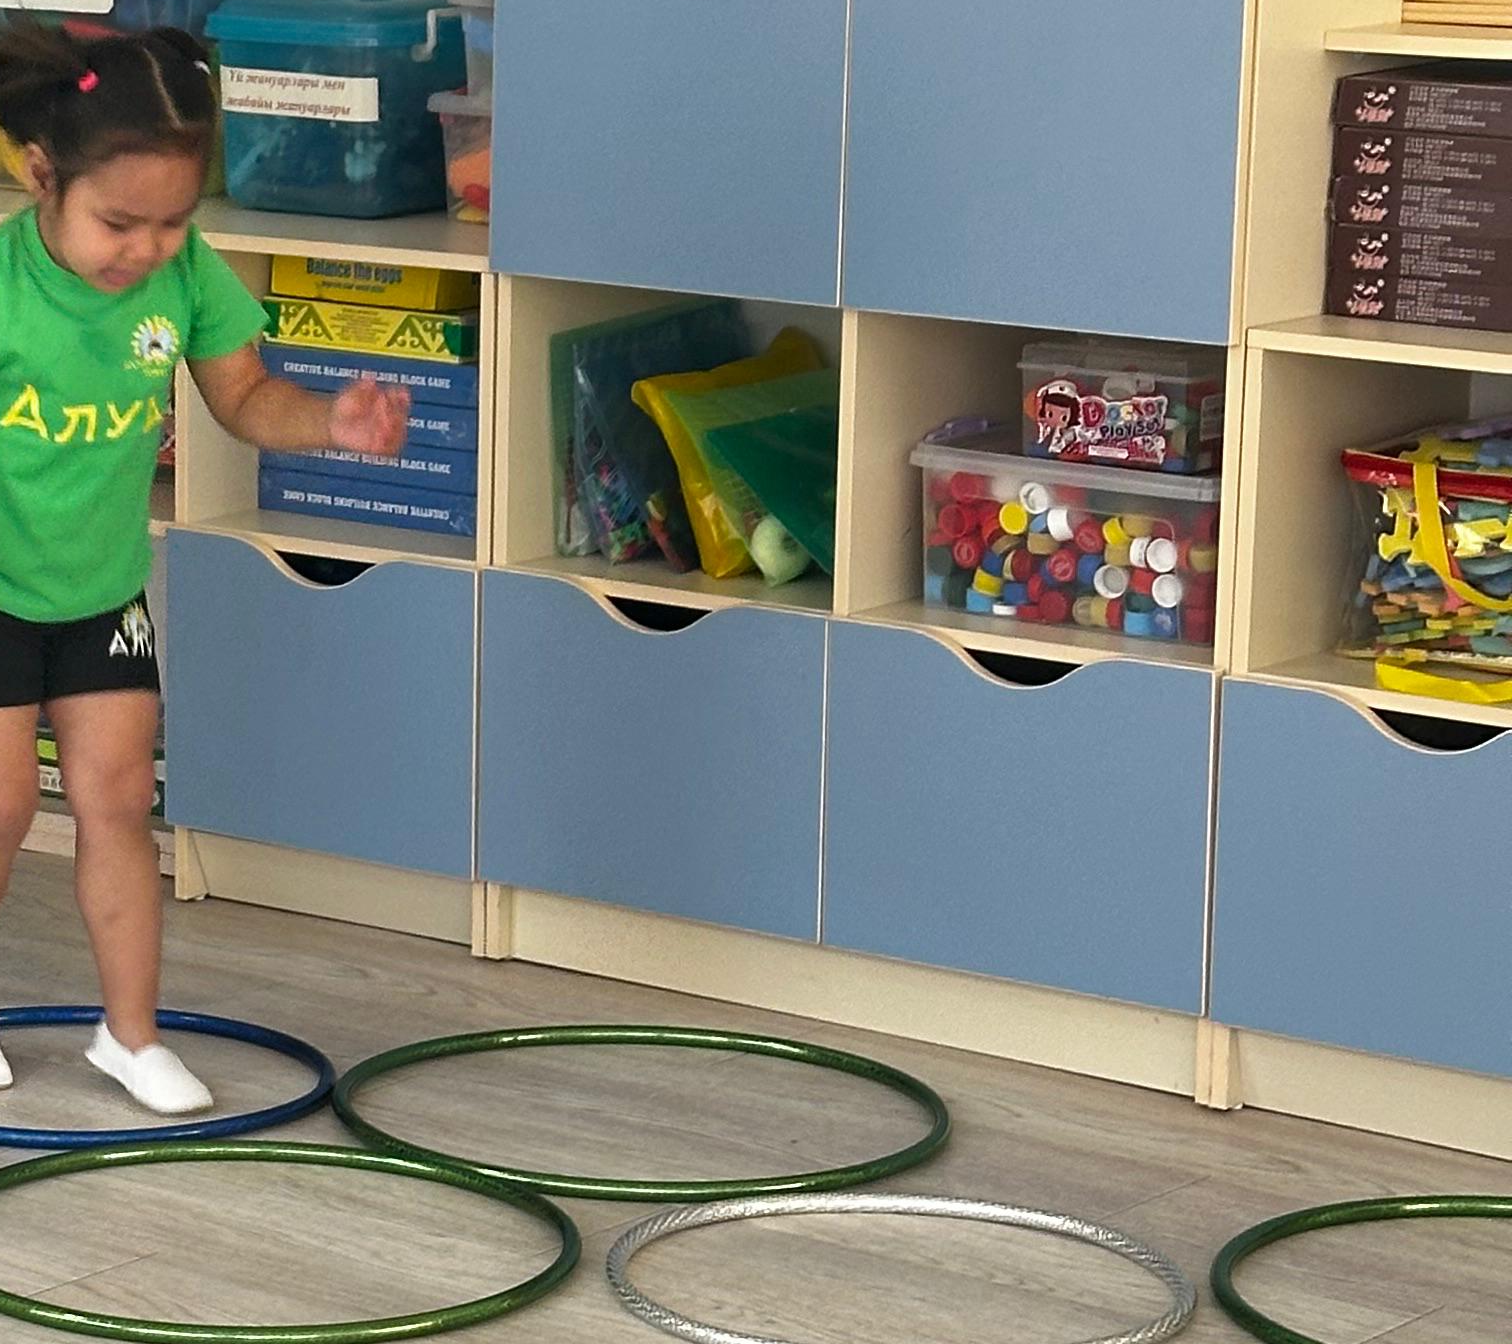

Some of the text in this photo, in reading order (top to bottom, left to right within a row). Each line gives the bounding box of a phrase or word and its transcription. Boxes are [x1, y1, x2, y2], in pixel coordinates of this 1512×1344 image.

[283, 361, 322, 376] CREATIVE
[324, 367, 360, 380] BALANCE
[400, 373, 426, 386] BLOCK
[428, 376, 451, 389] GAME
[400, 458, 426, 471] BLOCK
[428, 461, 451, 475] GAME
